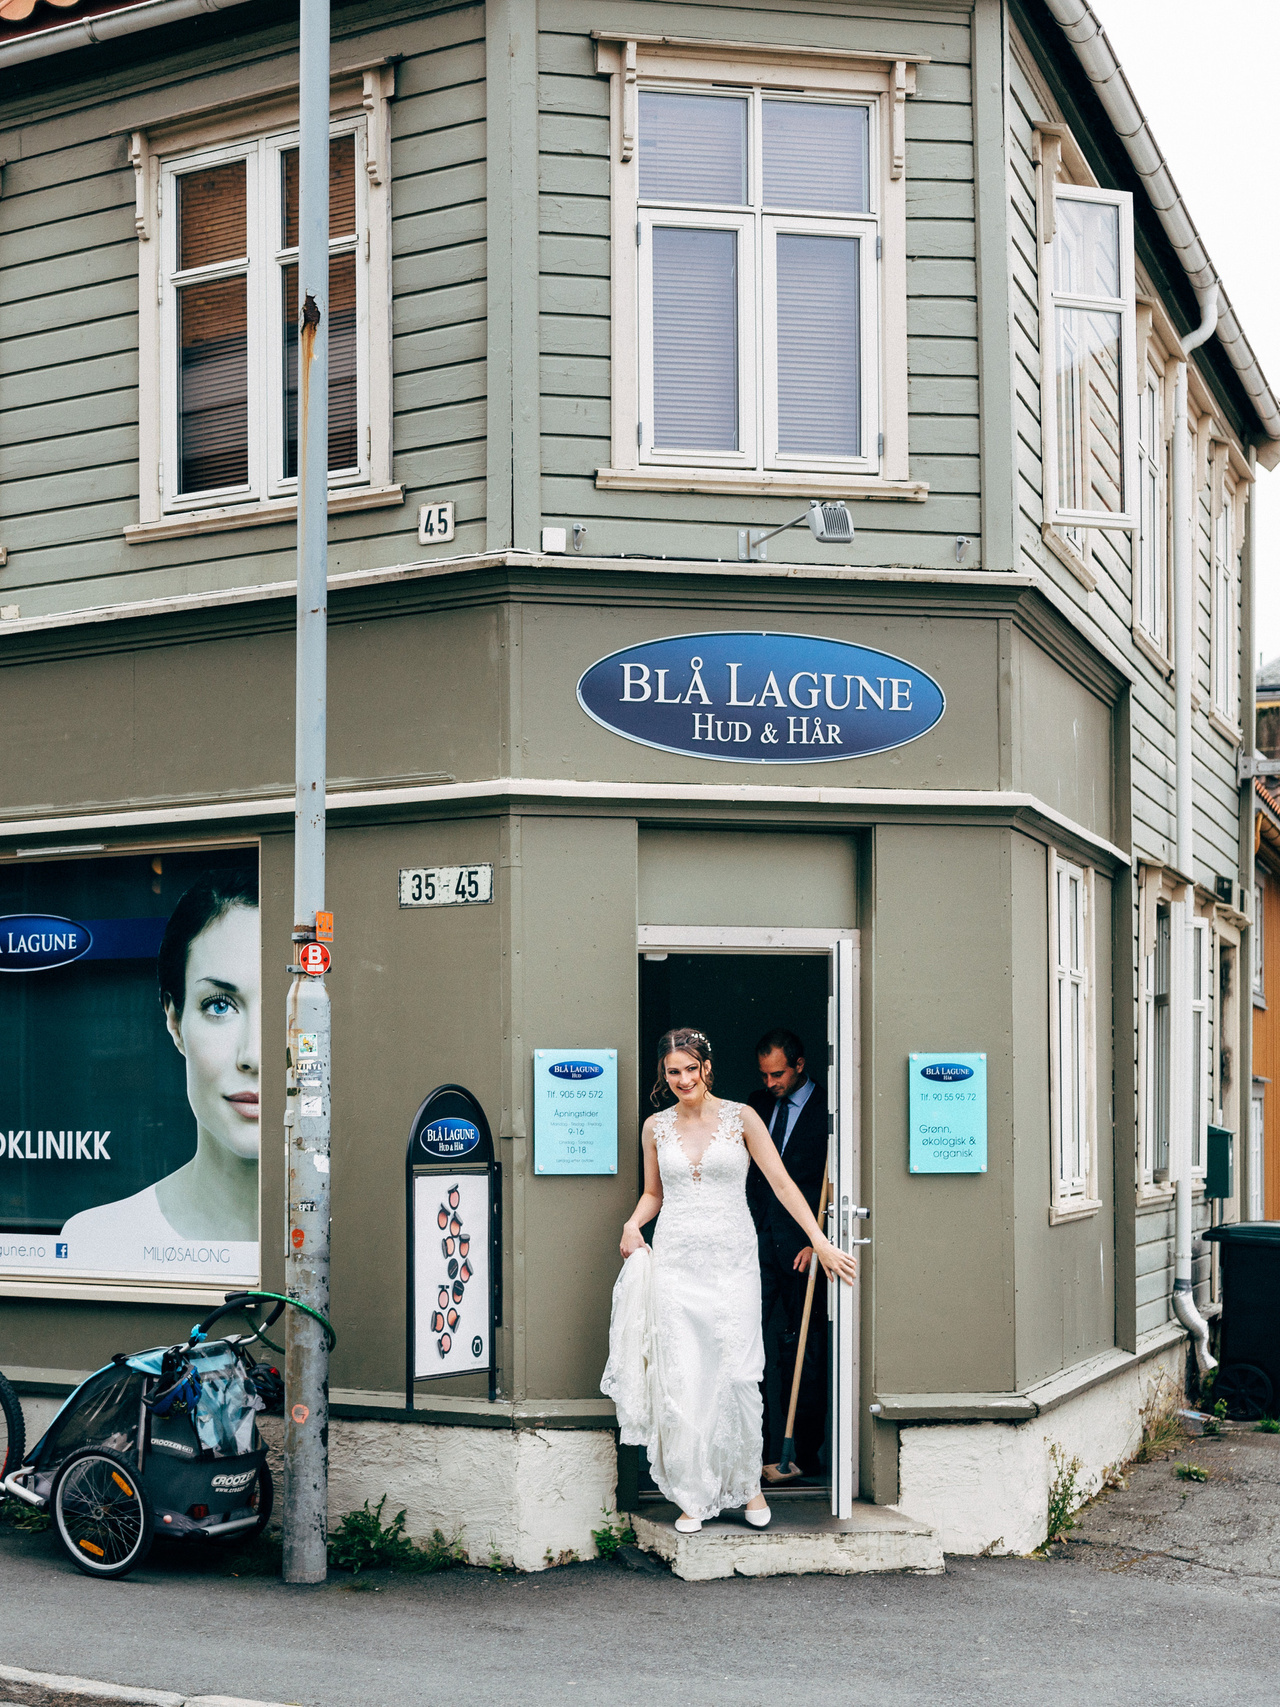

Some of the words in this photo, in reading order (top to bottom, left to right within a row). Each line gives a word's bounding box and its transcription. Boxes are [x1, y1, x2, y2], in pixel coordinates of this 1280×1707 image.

[424, 508, 448, 537] 45
[619, 656, 713, 705] BLÅ
[726, 663, 913, 711] LAGUNE
[692, 712, 752, 742] HUD
[760, 722, 779, 744] &
[786, 716, 843, 745] HÅR
[8, 932, 77, 953] LAGUNE
[308, 945, 322, 964] B
[554, 1064, 569, 1073] BLÅ
[570, 1065, 600, 1073] LAGUNE
[926, 1067, 940, 1075] BLÅ
[941, 1067, 970, 1075] LAGUNE
[559, 1090, 575, 1099] 905
[576, 1090, 587, 1099] 59
[588, 1090, 604, 1099] 572
[932, 1093, 942, 1101] 90
[944, 1093, 954, 1101] 55
[955, 1093, 965, 1101] 95
[967, 1093, 977, 1101] 72
[553, 1109, 599, 1118] Åpningstider
[427, 1126, 443, 1142] BLÅ
[444, 1127, 475, 1141] LAGUNE
[568, 1128, 585, 1136] 9-16
[919, 1124, 952, 1134] Grønn,
[438, 1142, 449, 1151] HUD
[921, 1136, 966, 1147] økologisk
[968, 1136, 977, 1146] &
[567, 1146, 587, 1154] 10-18
[933, 1149, 973, 1160] organisk
[143, 1246, 230, 1263] MILJØSALONG
